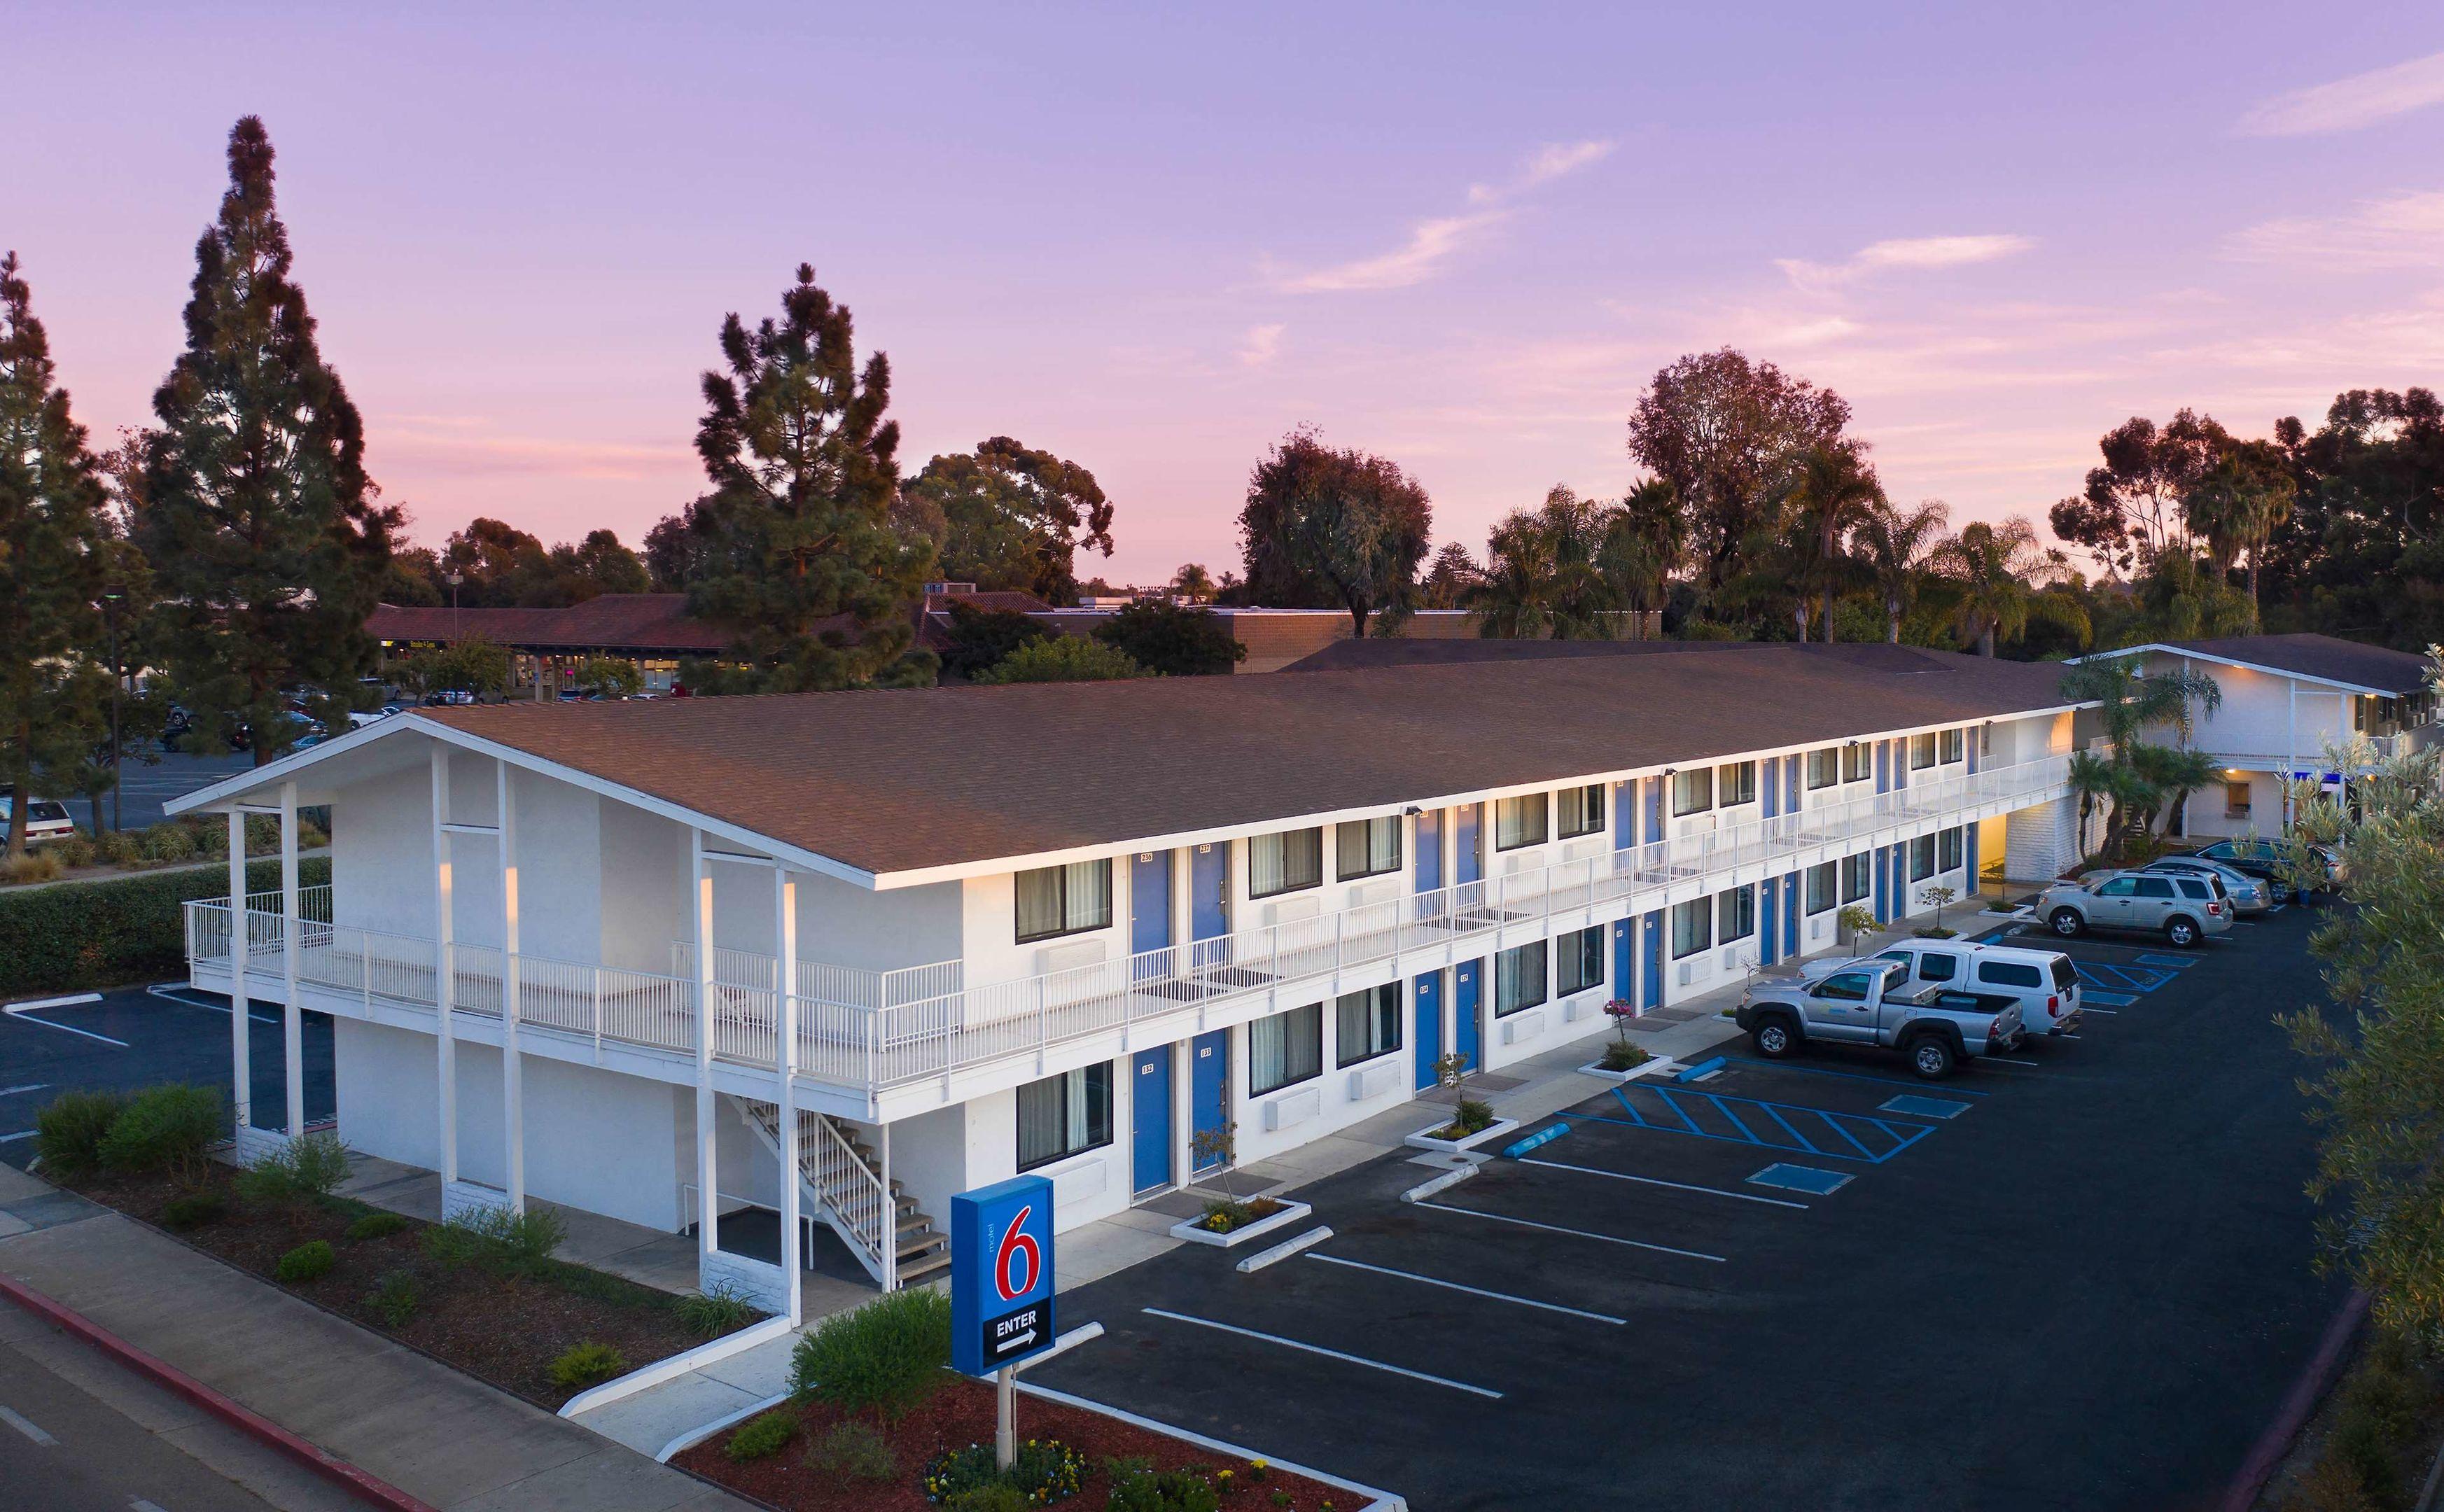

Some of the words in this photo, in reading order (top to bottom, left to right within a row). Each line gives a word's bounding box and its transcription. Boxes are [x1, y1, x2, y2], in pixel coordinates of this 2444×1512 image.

[1201, 844, 1210, 853] 237
[1142, 853, 1152, 862] 236
[1201, 1048, 1210, 1056] 133
[1143, 1065, 1152, 1073] 132
[995, 1205, 1040, 1301] 6
[997, 1310, 1036, 1337] ENTER
